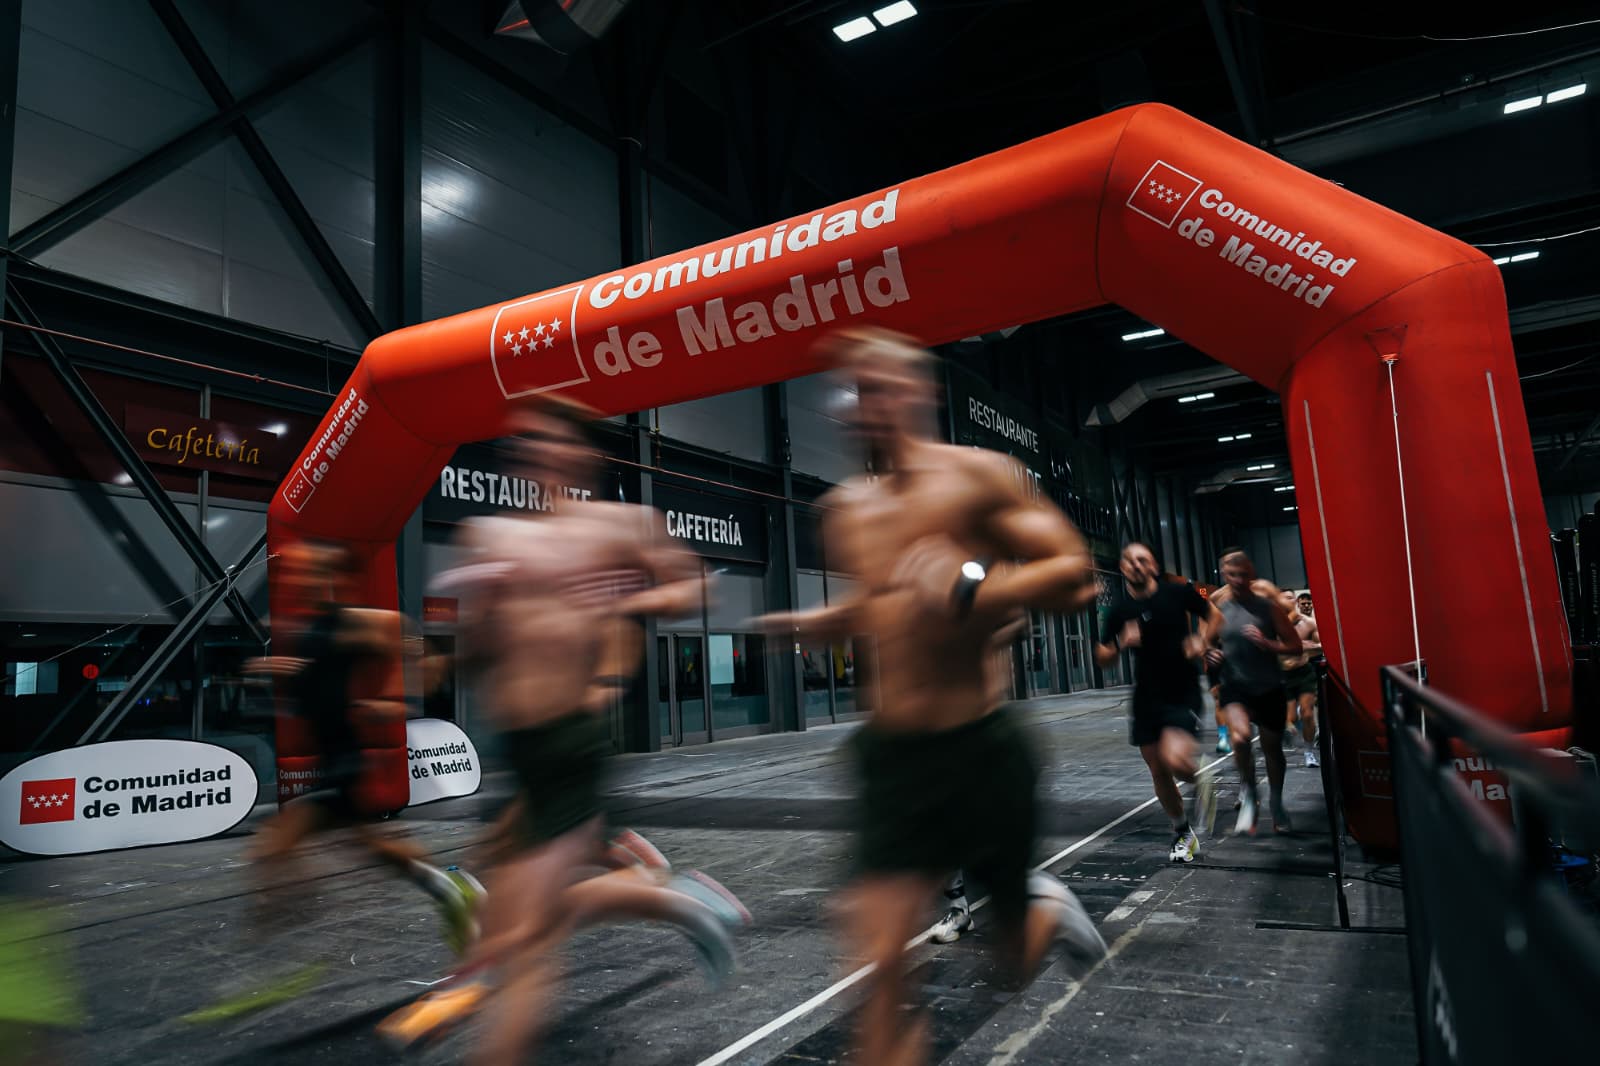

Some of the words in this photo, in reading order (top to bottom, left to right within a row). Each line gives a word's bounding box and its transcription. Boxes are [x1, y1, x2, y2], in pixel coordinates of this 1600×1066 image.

[589, 188, 900, 308] Comunidad
[1199, 188, 1357, 278] Comunidad
[1177, 217, 1215, 247] de
[1219, 234, 1335, 309] Madrid
[593, 326, 664, 377] de
[675, 246, 910, 356] Madrid
[146, 426, 260, 465] Cafetería
[303, 387, 358, 471] Comunidad
[312, 461, 329, 484] de
[325, 398, 369, 461] Madrid
[968, 396, 1039, 453] RESTAURANTE
[665, 509, 743, 546] CAFETERÍA
[279, 767, 322, 780] Comuni
[407, 742, 467, 761] Comunidad
[412, 764, 429, 780] de
[431, 758, 472, 776] Madrid
[83, 765, 232, 794] Comunidad
[83, 798, 120, 819] de
[131, 787, 232, 815] Madrid
